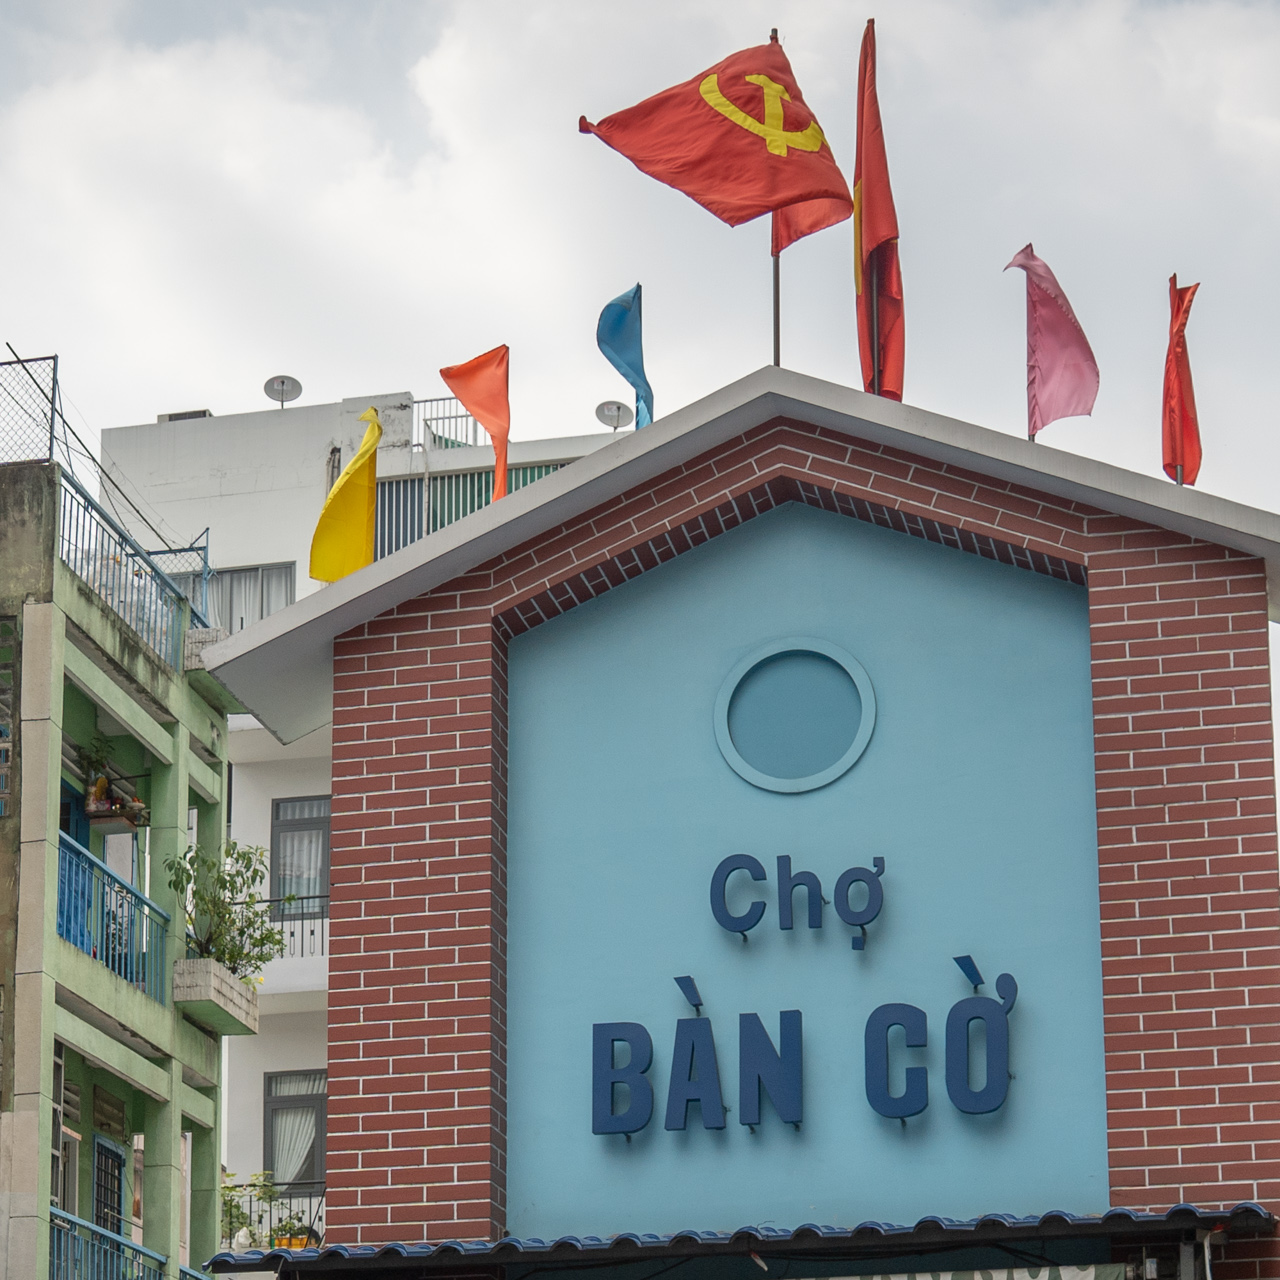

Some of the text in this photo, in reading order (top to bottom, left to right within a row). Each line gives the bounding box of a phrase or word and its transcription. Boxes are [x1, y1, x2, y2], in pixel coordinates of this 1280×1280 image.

[709, 853, 886, 951] Chợ
[591, 954, 1019, 1136] BÀN CỜ
